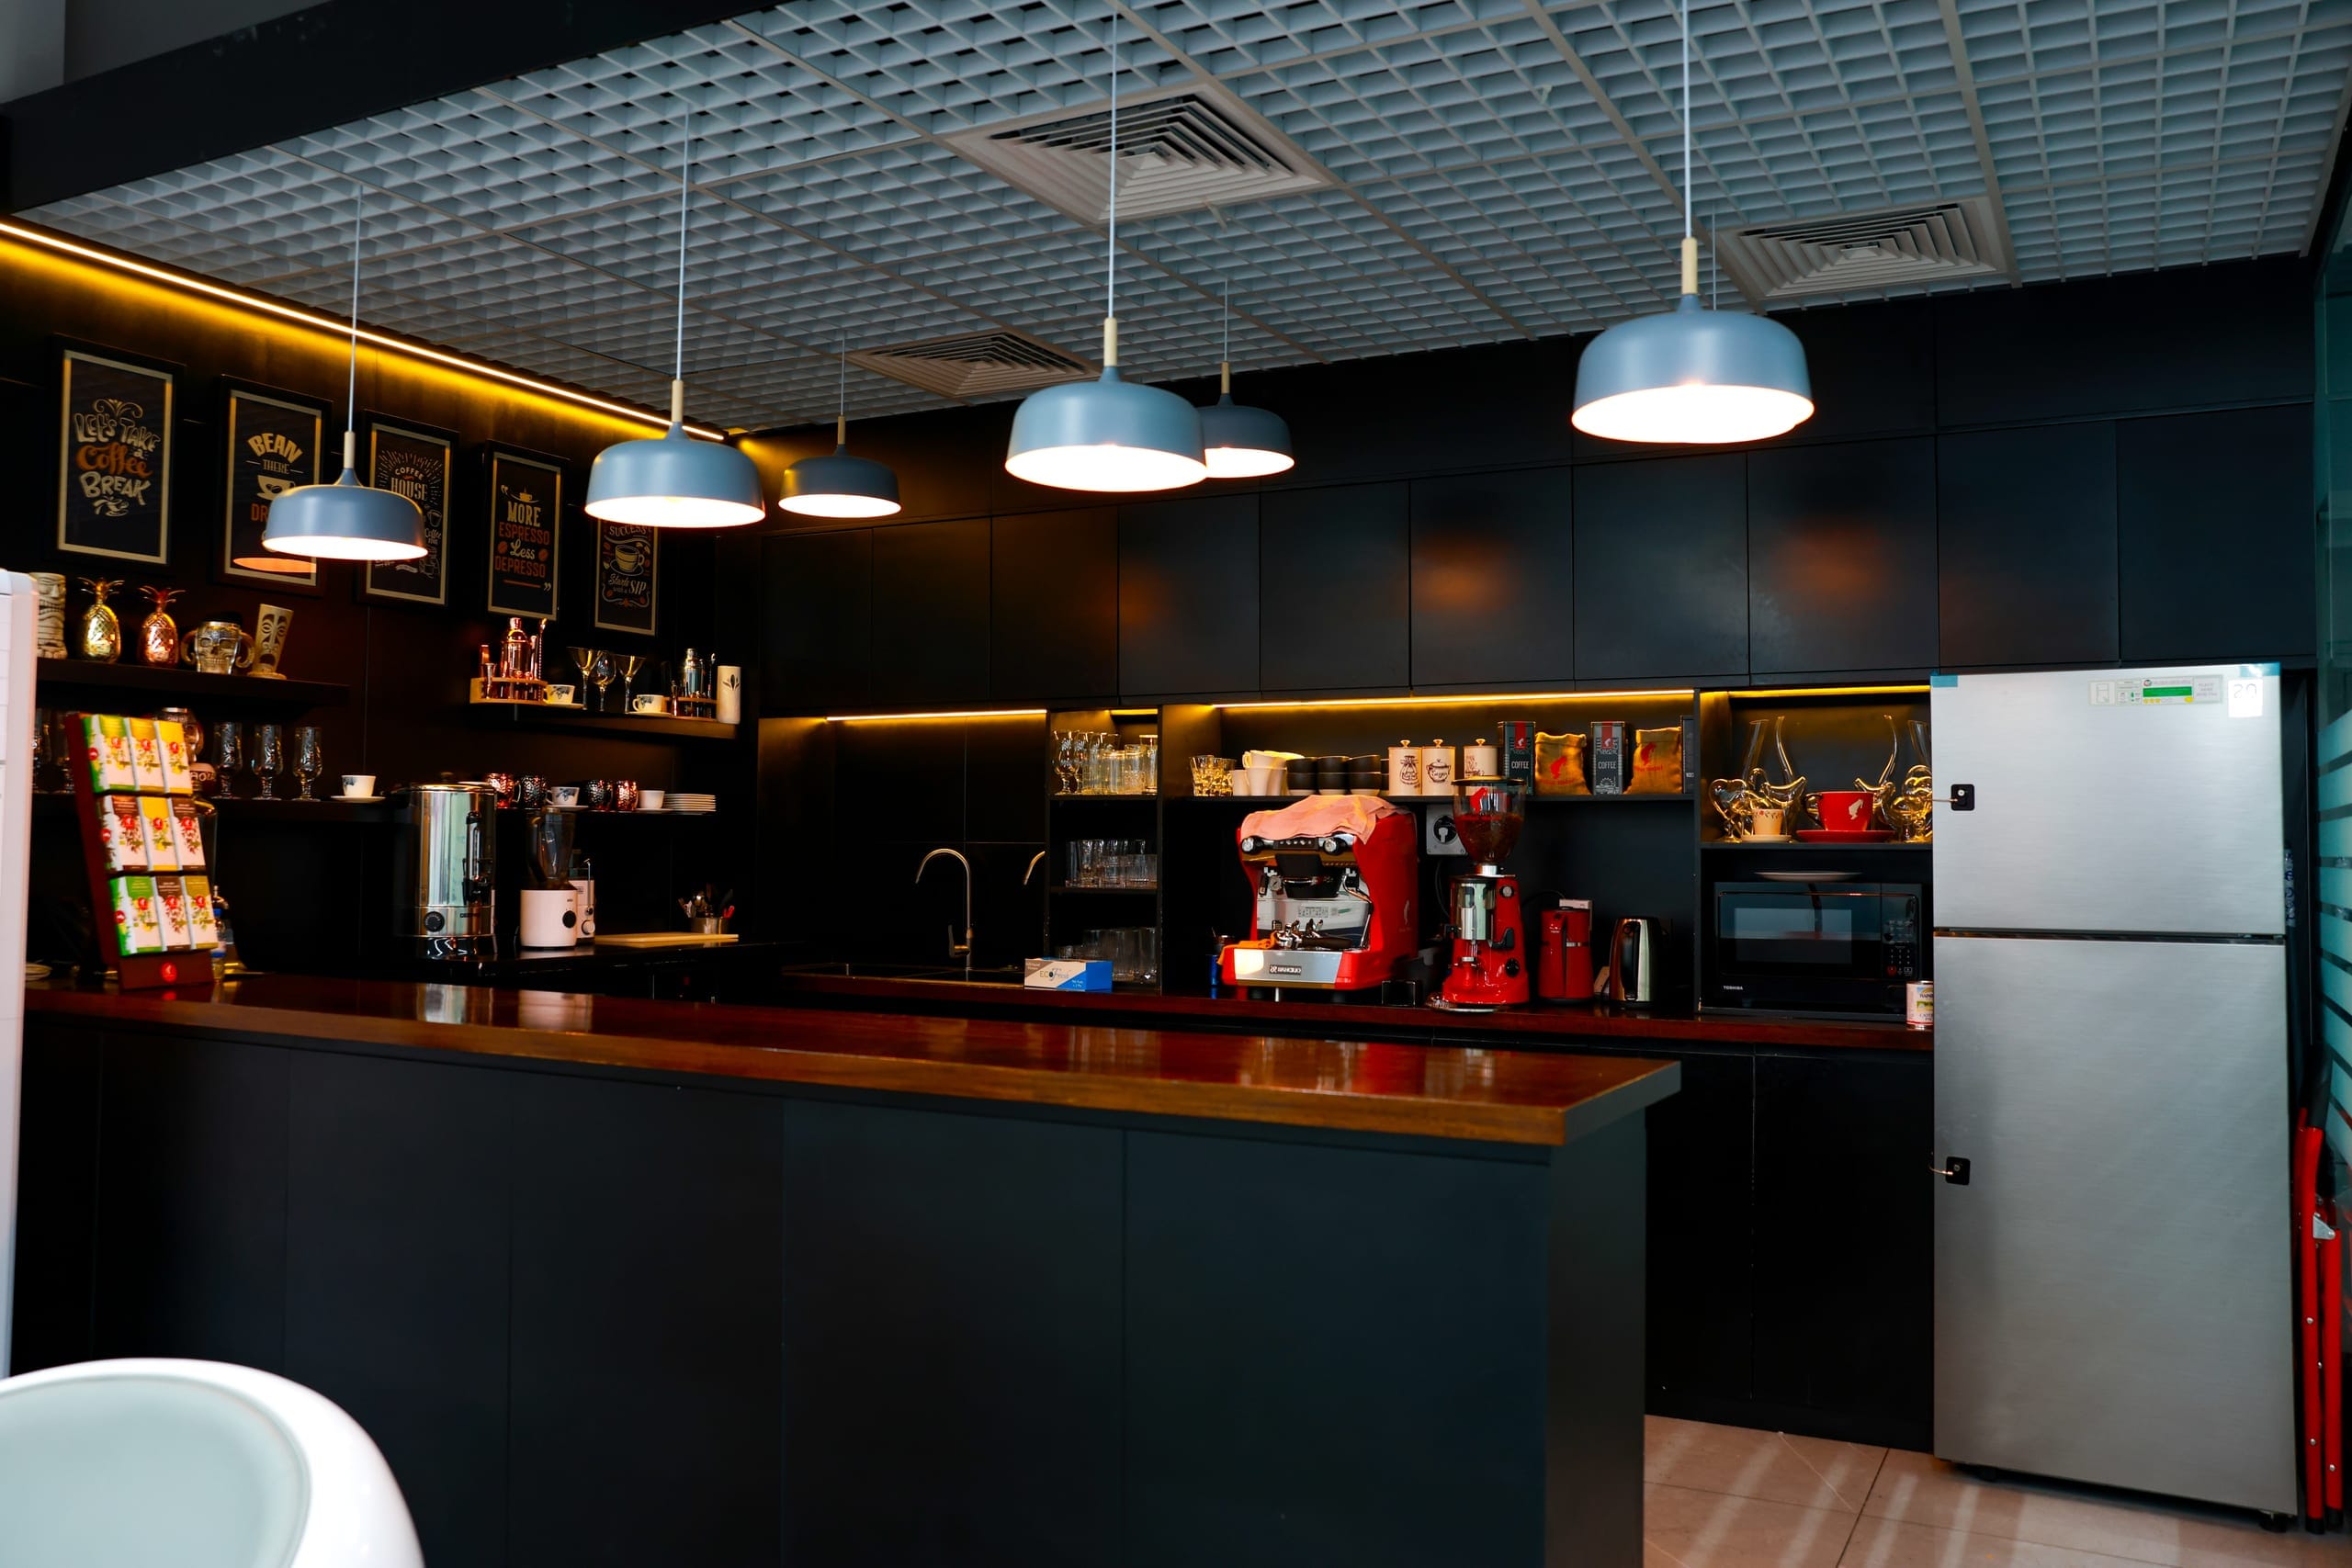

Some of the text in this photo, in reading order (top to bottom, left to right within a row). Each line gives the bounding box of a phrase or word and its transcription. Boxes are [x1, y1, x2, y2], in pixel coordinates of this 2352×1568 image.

[119, 417, 162, 453] TAKE
[75, 441, 154, 479] Coffee
[246, 432, 305, 464] BEAN
[263, 458, 290, 475] THERE
[395, 467, 424, 481] COFFEE
[79, 470, 152, 506] BREAK
[390, 477, 428, 502] HOUSE
[507, 501, 542, 528] MORE
[499, 521, 550, 546] ESPRESSO
[510, 536, 536, 560] Less
[494, 555, 547, 578] DEPRESSO
[629, 580, 647, 595] SIP
[1511, 761, 1530, 770] COFFEE
[1598, 761, 1618, 770] COFFEE
